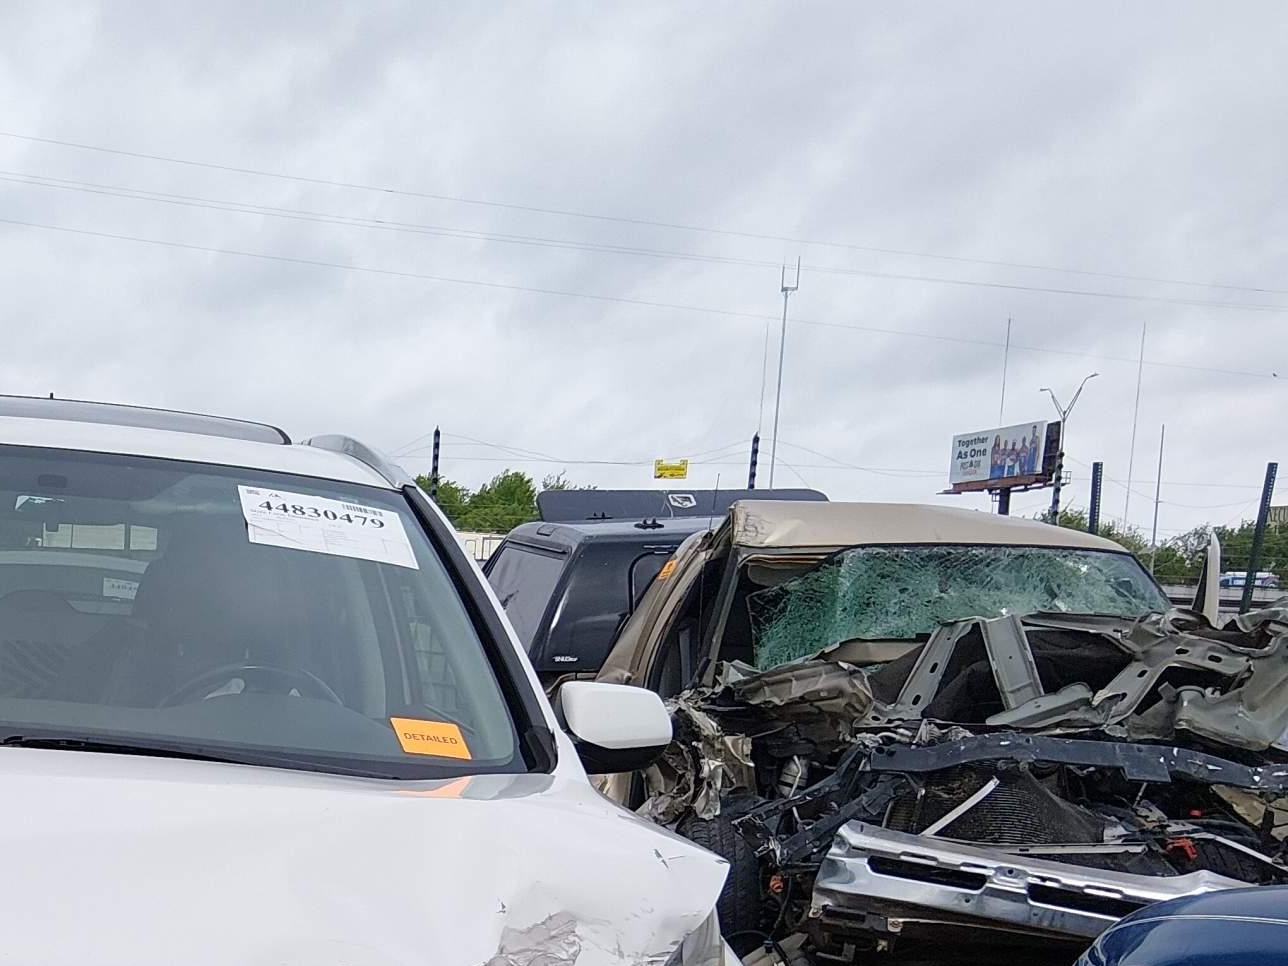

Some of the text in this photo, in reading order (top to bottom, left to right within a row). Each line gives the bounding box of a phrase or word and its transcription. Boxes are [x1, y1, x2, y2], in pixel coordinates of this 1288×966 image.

[957, 436, 989, 448] Together
[956, 448, 987, 460] As One
[258, 500, 385, 529] 44830479
[403, 732, 458, 745] DETAILED
